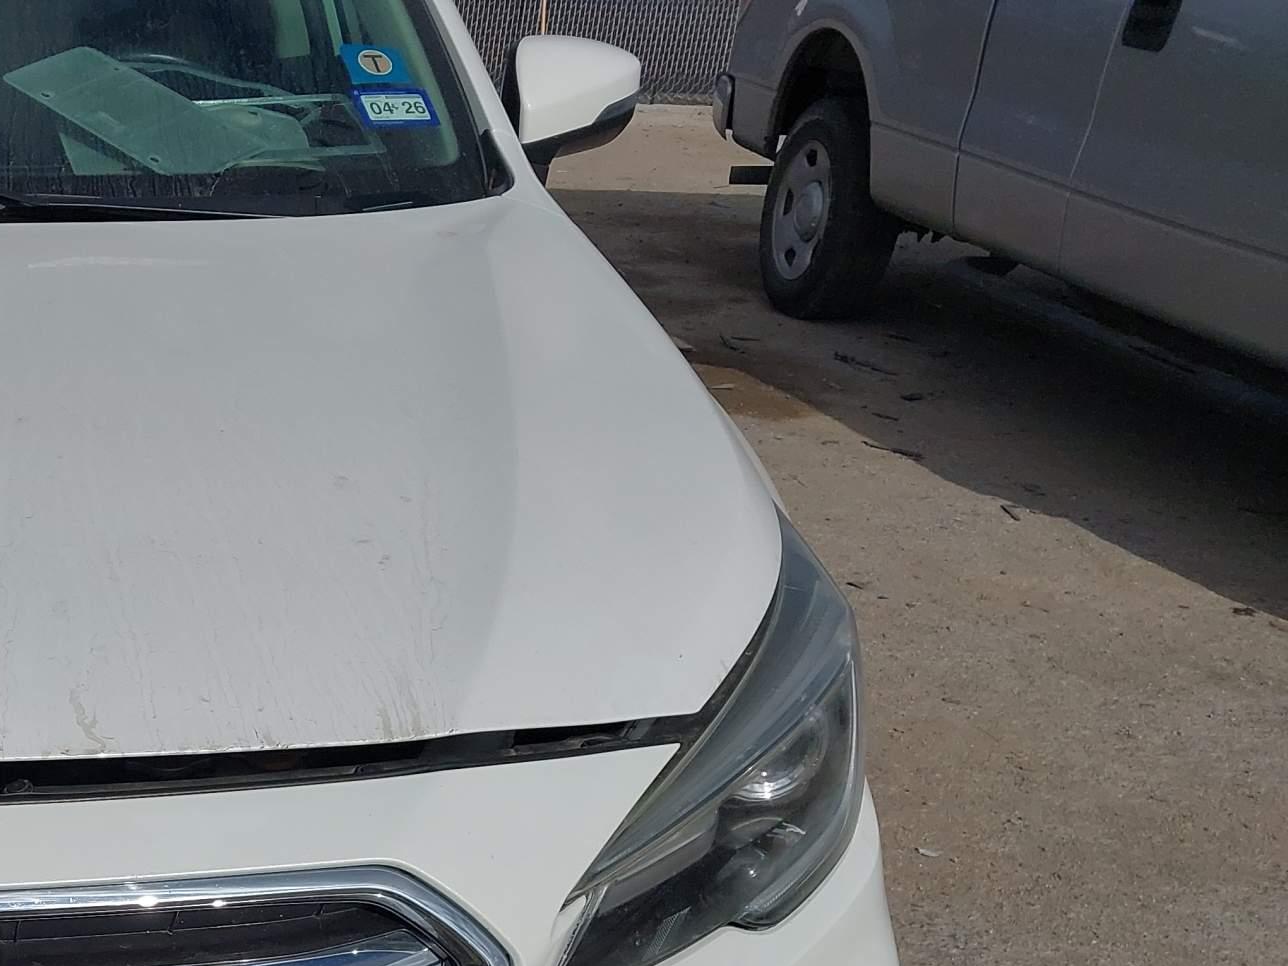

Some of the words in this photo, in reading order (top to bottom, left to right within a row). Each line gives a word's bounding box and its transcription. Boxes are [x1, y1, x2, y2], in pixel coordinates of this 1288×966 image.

[363, 54, 383, 73] T
[370, 102, 394, 115] 04
[402, 101, 426, 114] 26
